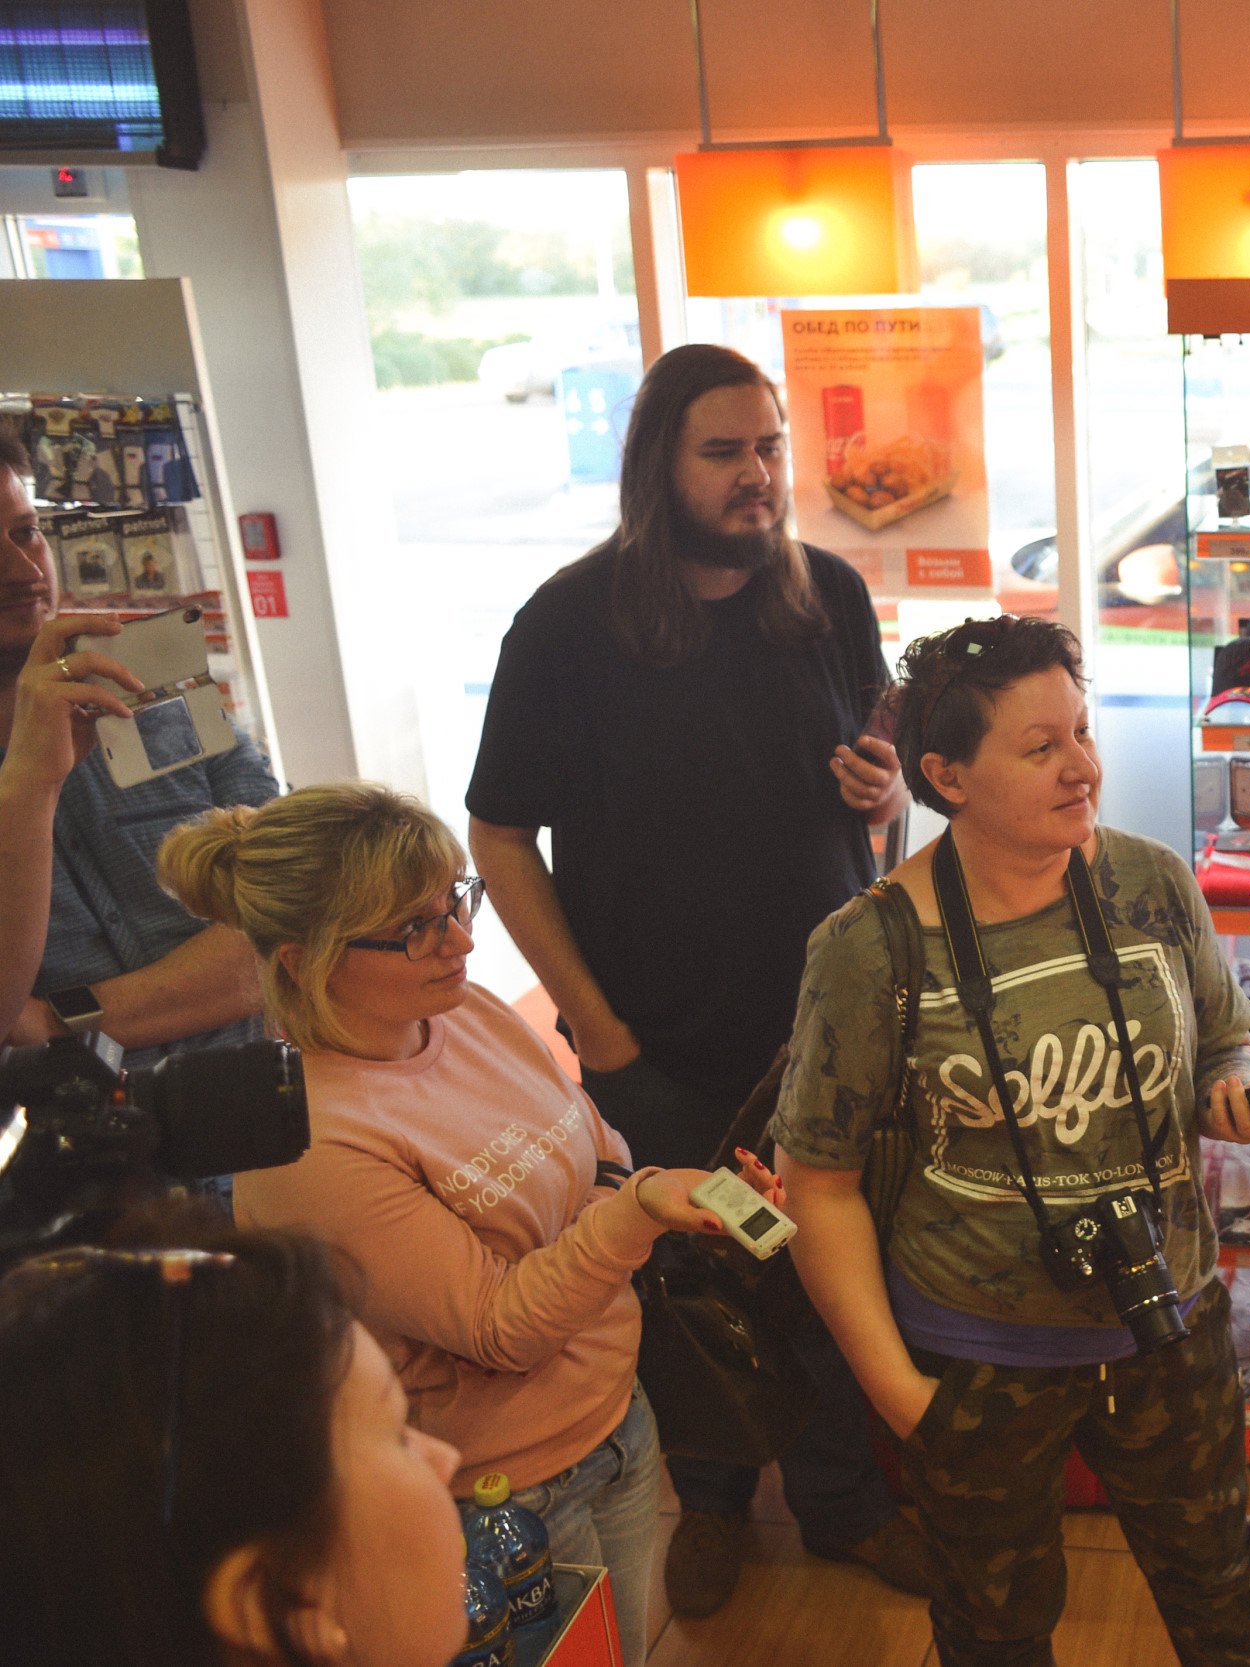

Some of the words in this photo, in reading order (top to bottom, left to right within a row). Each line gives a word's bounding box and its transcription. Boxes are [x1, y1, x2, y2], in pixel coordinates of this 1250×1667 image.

[793, 321, 839, 335] ОБЕД
[845, 320, 869, 333] ПО
[875, 320, 921, 333] ПУТИ
[254, 594, 278, 615] 01
[939, 1020, 1172, 1145] Selfie
[945, 1160, 1090, 1187] MOSCOW-PAIS-TOK
[468, 1179, 512, 1214] YOU
